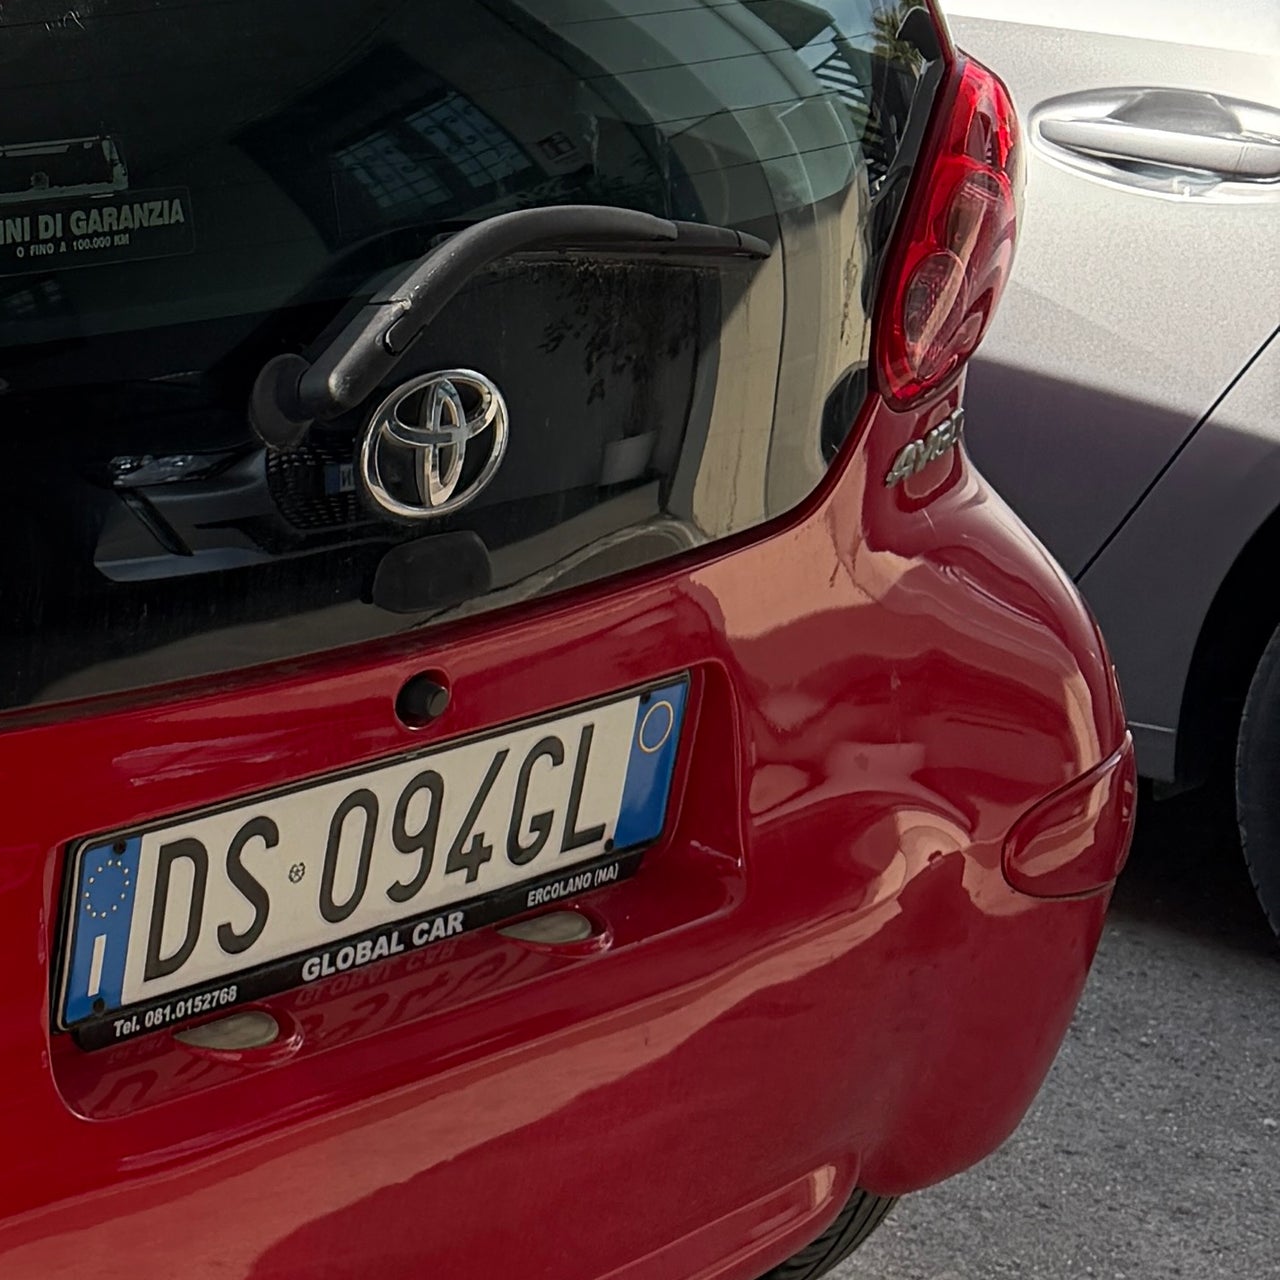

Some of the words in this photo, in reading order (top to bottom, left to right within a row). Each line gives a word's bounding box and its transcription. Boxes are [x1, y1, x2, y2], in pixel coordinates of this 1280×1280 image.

[38, 213, 63, 239] DI
[70, 198, 185, 235] GARANZIA
[30, 243, 55, 257] FINO
[60, 241, 67, 253] A
[72, 236, 111, 251] 100.000
[114, 233, 130, 247] KM
[143, 815, 280, 982] DS
[317, 722, 609, 925] 094GL
[526, 874, 590, 908] ERCOLANO
[593, 861, 620, 887] (NA)
[300, 933, 406, 983] GLOBAL
[412, 910, 465, 948] CAR
[113, 1014, 141, 1039] Tel.
[143, 984, 239, 1029] 081.0152768
